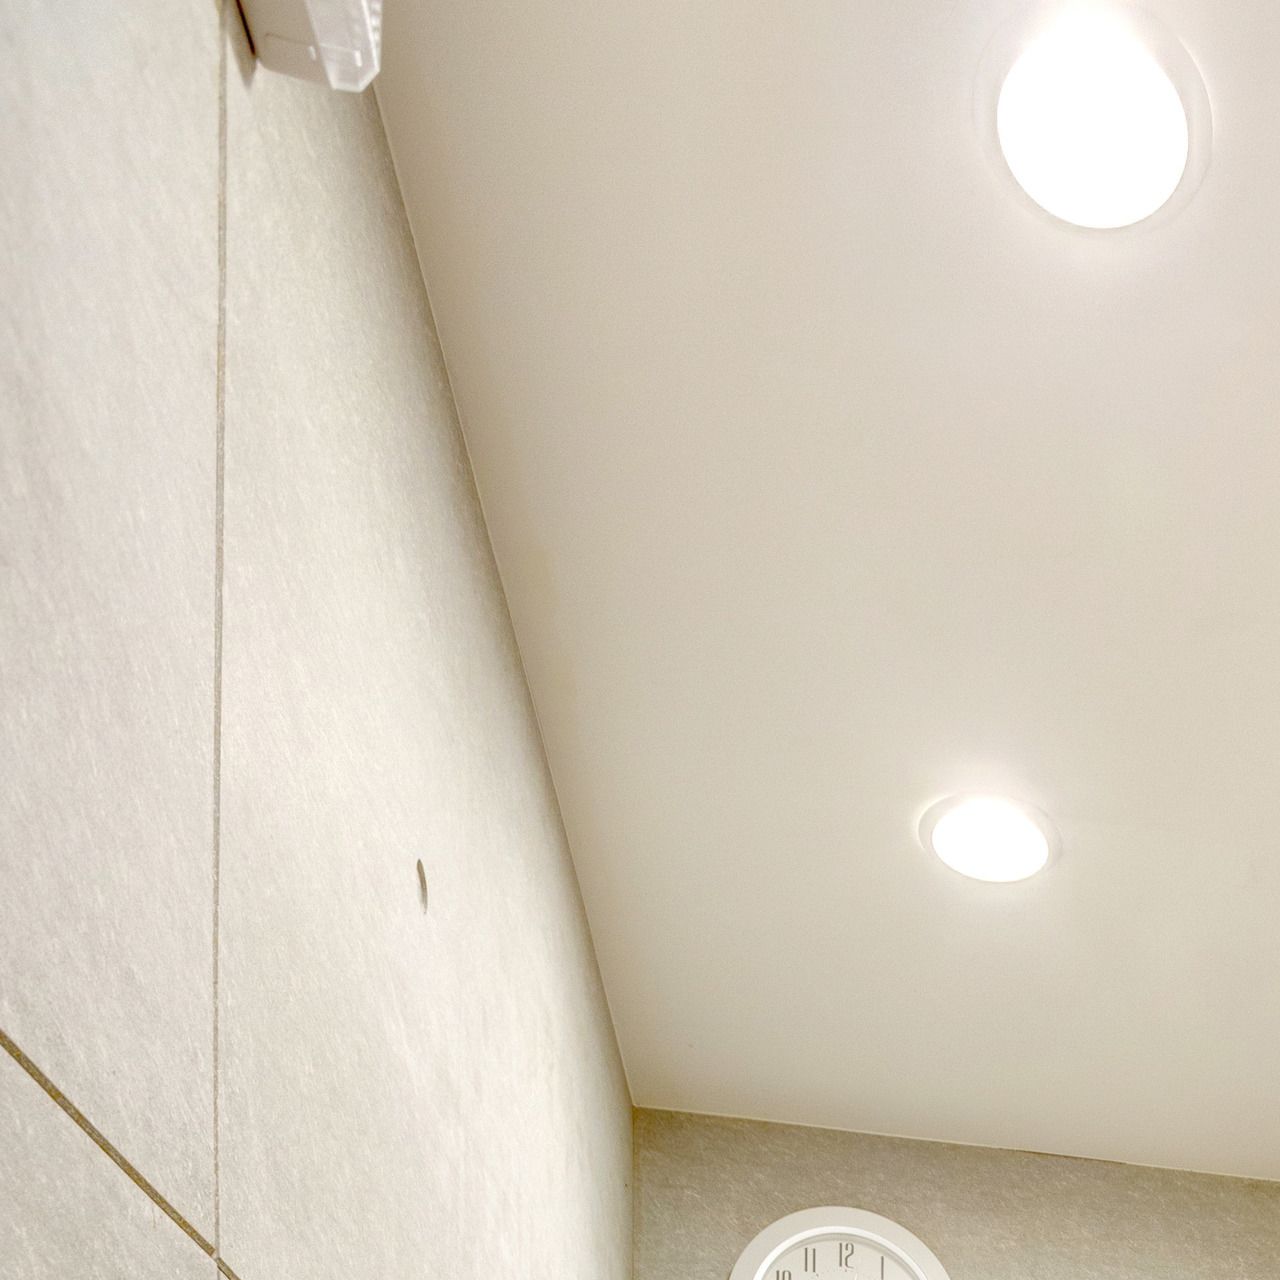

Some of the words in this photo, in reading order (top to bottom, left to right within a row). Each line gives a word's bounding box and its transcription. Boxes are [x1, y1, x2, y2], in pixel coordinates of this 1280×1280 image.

[804, 1247, 817, 1273] 11
[839, 1242, 855, 1268] 12
[880, 1255, 885, 1280] 1
